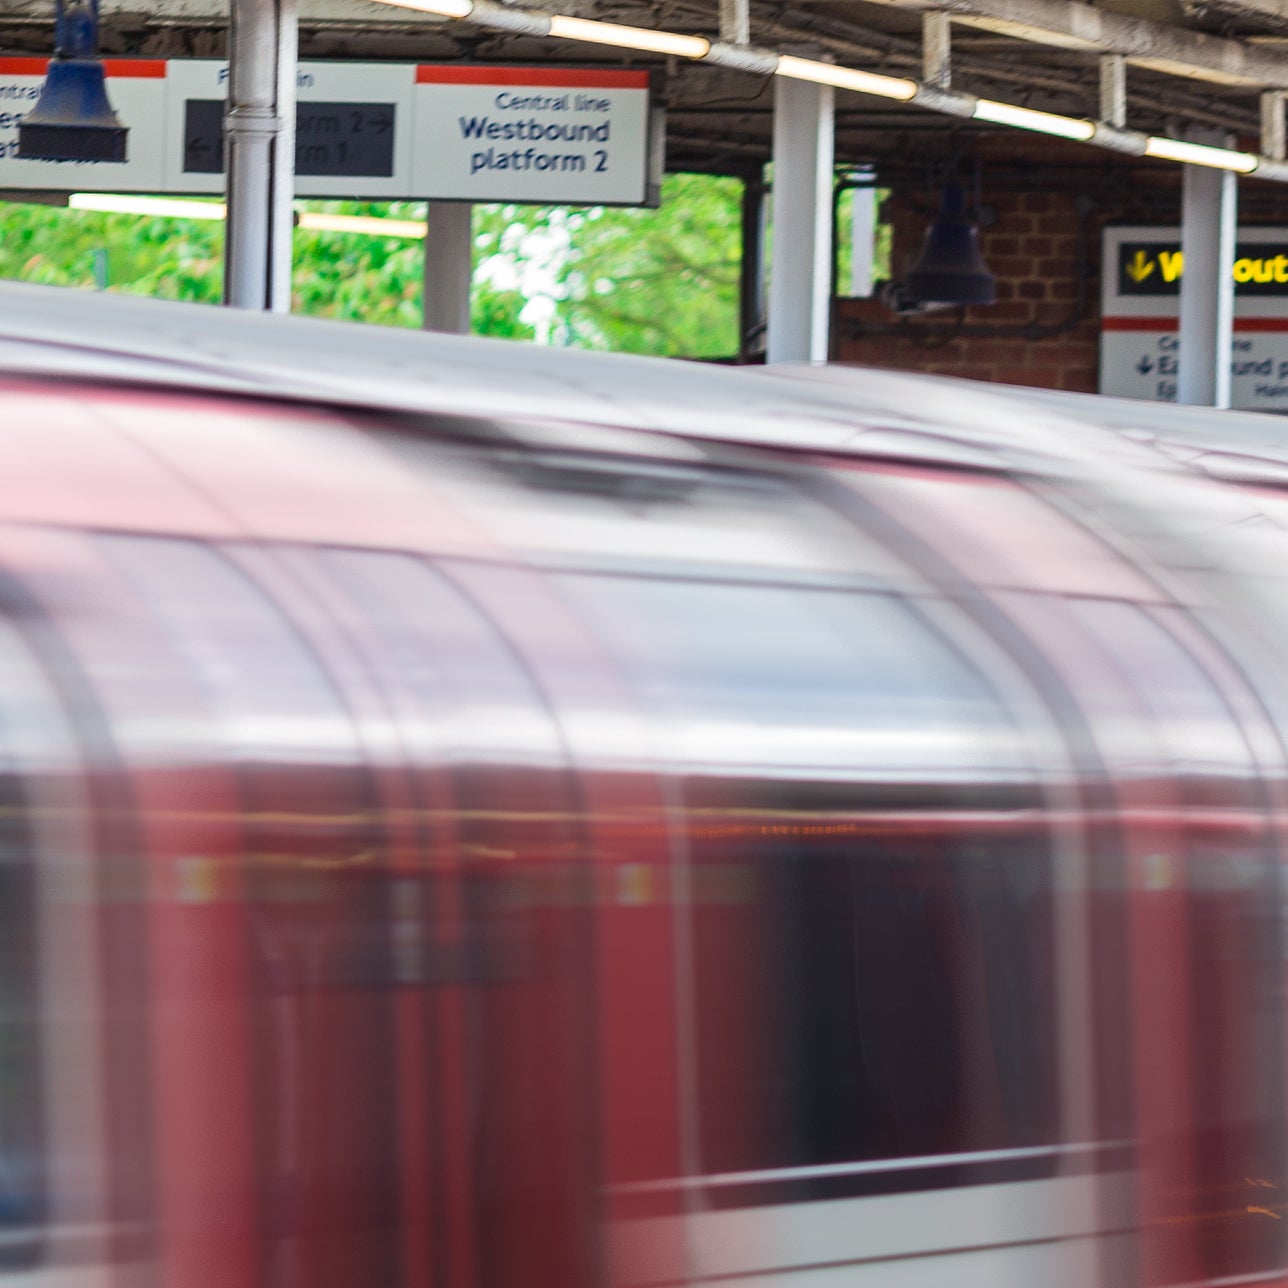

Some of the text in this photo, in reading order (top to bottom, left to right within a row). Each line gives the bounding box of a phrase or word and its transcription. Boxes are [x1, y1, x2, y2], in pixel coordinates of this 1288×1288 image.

[495, 92, 611, 112] Central line
[459, 116, 611, 142] Westbound
[470, 147, 609, 175] platform 2
